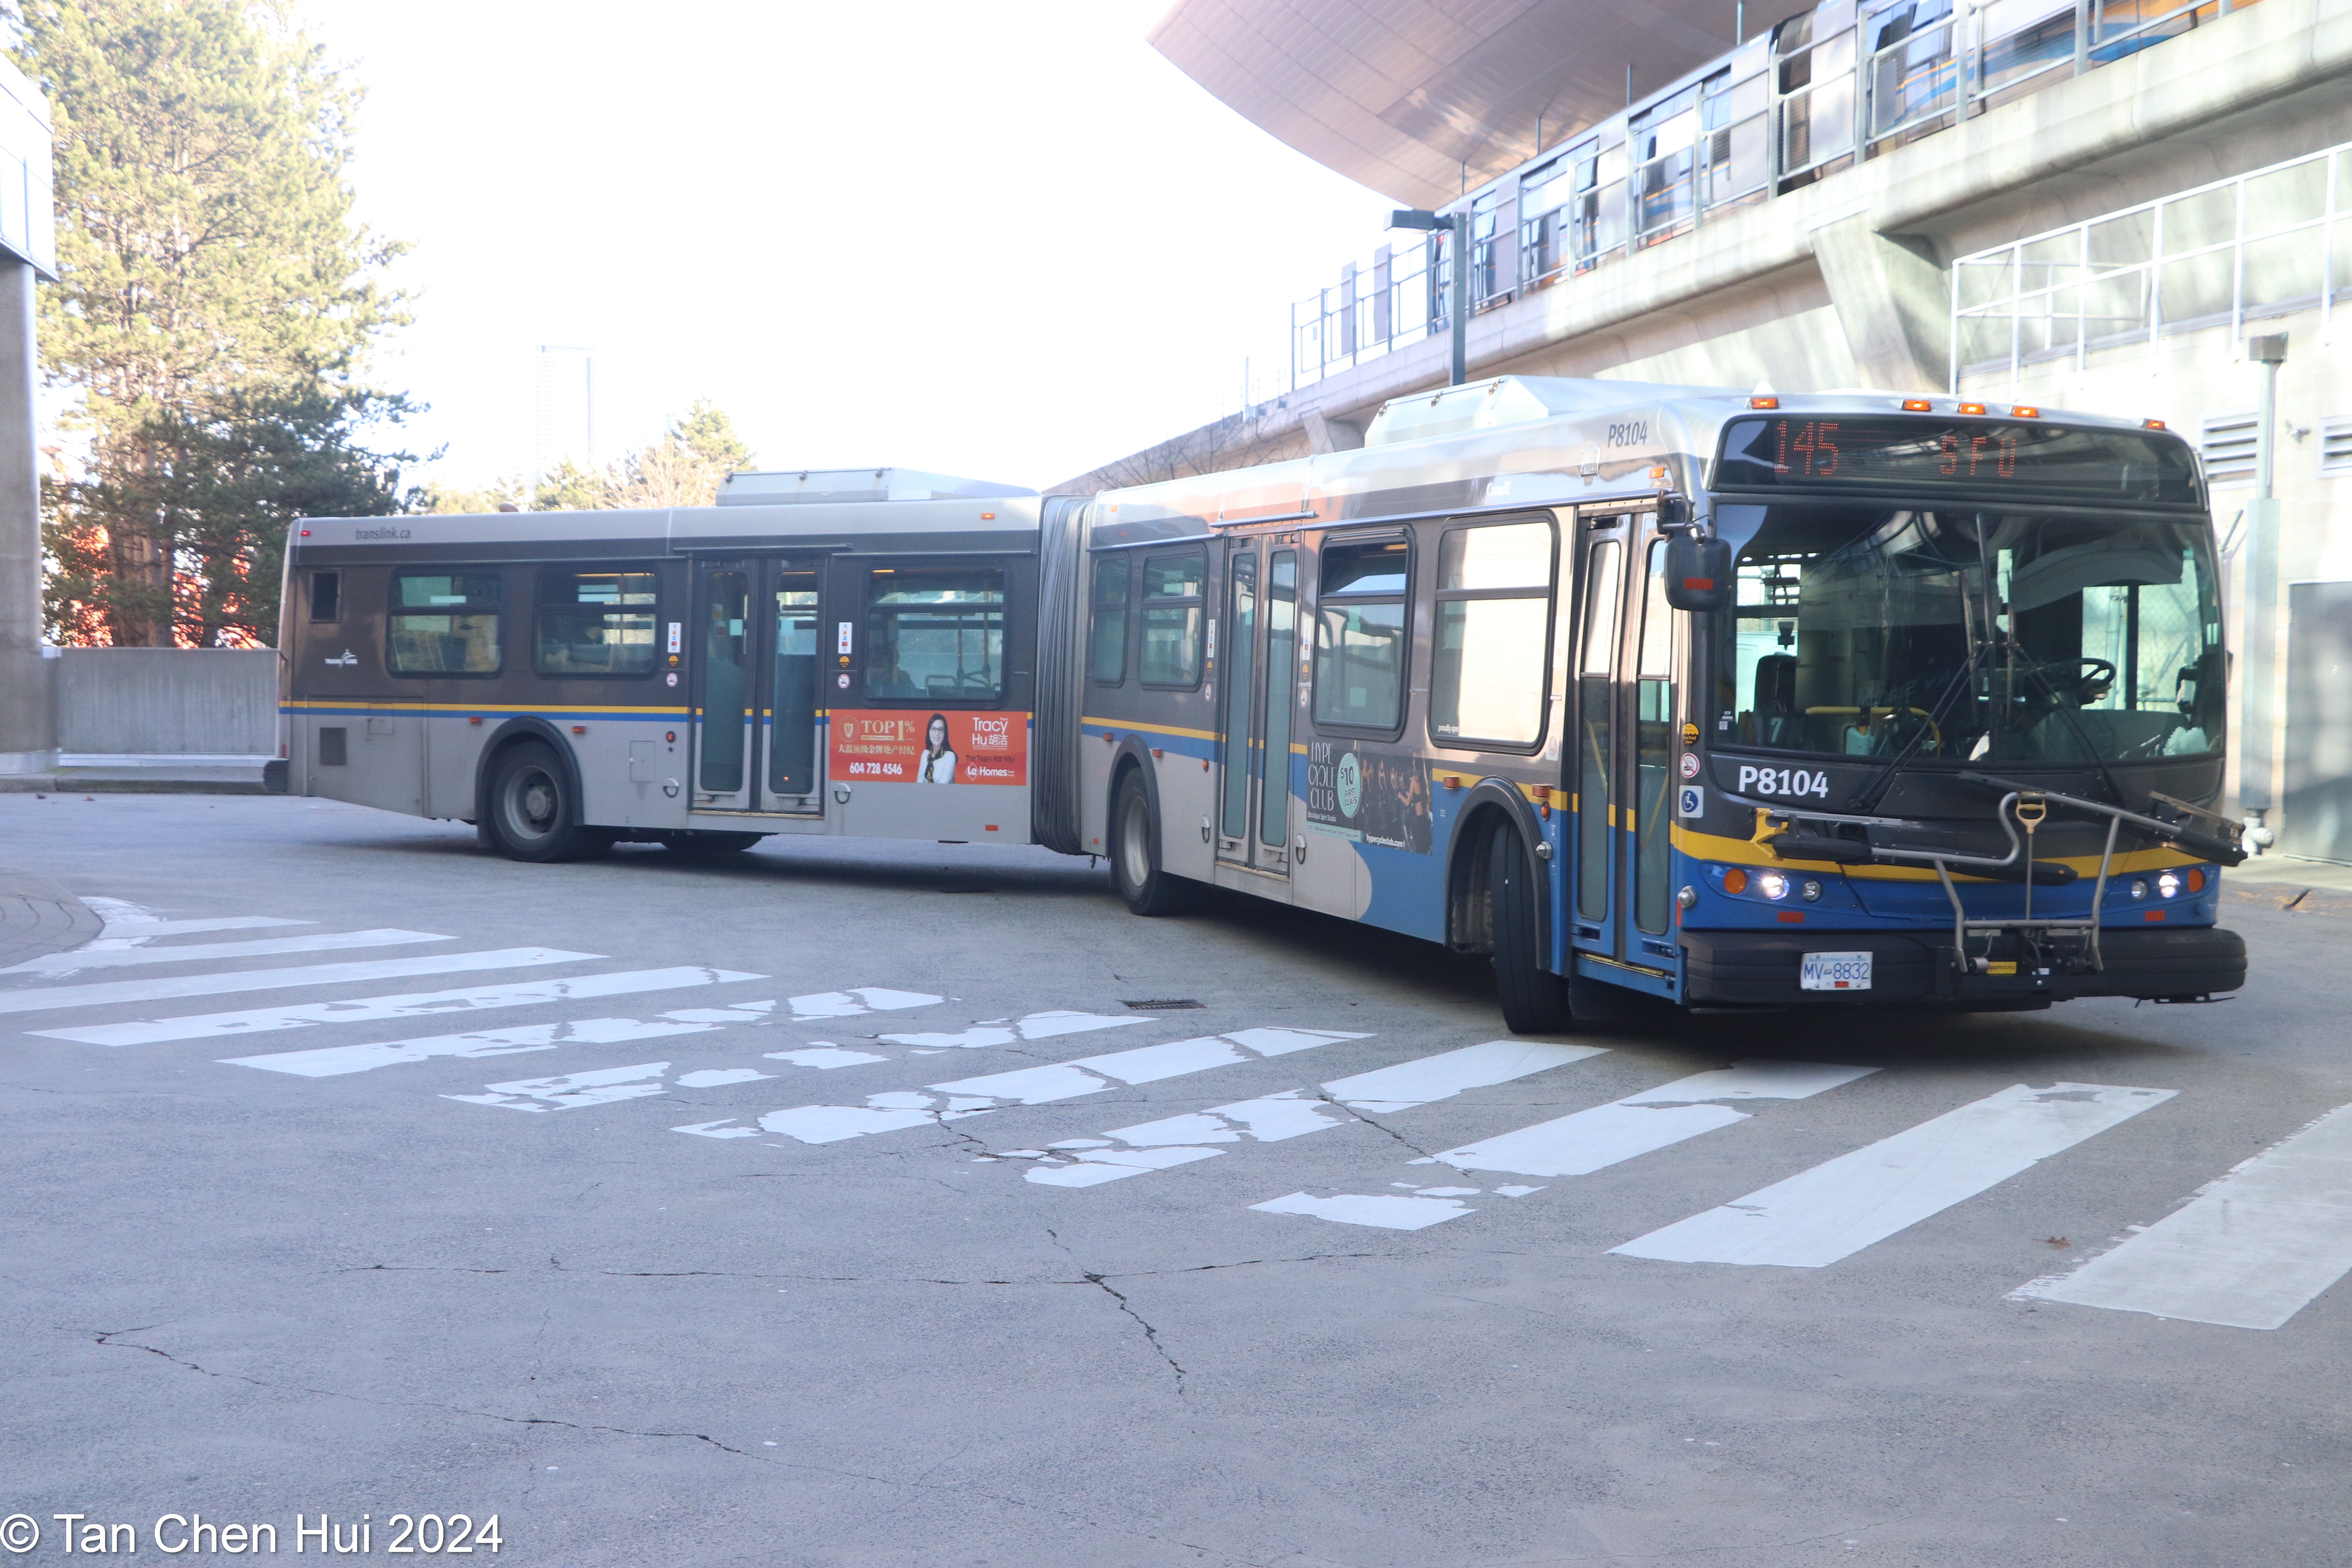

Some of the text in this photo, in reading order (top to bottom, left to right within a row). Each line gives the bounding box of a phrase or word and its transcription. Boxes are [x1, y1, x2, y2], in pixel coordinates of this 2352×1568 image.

[1608, 420, 1647, 448] P8104
[1775, 421, 2016, 477] 145 SFU
[1486, 482, 1510, 496] Canada
[356, 527, 410, 539] translink.ca
[861, 720, 915, 741] TOP 1%
[973, 717, 1008, 734] Tracy
[1438, 724, 1451, 733] proudly
[1771, 717, 1783, 742] 7
[972, 733, 1008, 745] Hu 胡洁
[1312, 742, 1334, 764] HYPE
[849, 762, 902, 775] 604 728 4546
[967, 766, 977, 775] Le
[980, 766, 1007, 776] Homes
[1308, 764, 1336, 788] CYCLE
[1340, 766, 1354, 786] $10
[1738, 765, 1829, 798] P8104
[1310, 788, 1334, 811] CLUB
[1345, 788, 1355, 797] FIRST
[1345, 797, 1357, 806] CLASS
[1308, 811, 1320, 820] Boutique
[1367, 833, 1403, 848] hypecycleclub.com
